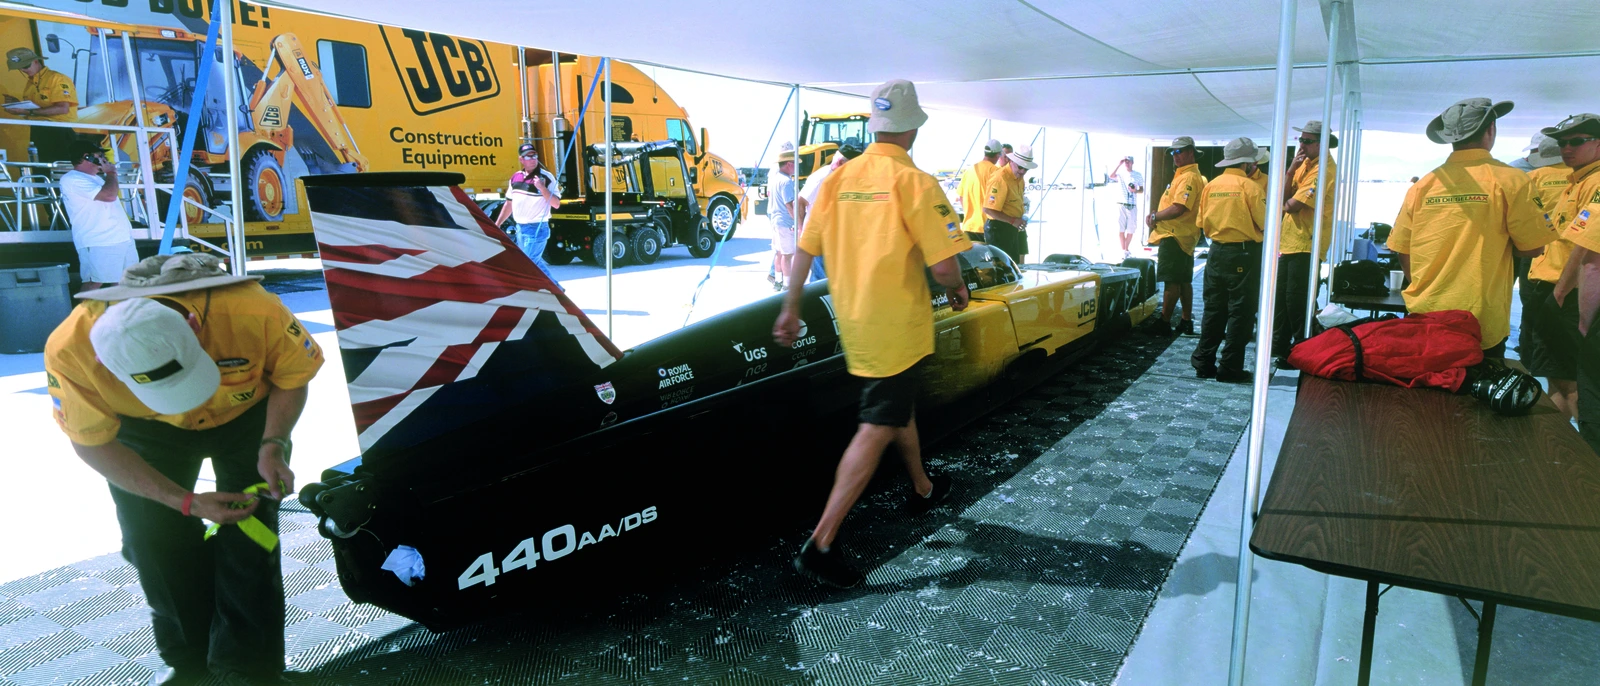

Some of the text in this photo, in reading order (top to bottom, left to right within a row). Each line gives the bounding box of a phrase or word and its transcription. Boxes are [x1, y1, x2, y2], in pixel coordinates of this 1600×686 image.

[402, 28, 492, 104] JCB
[263, 107, 280, 125] JCB
[389, 126, 503, 147] Construction
[402, 147, 497, 169] Equipment
[712, 159, 723, 177] JCB
[1077, 298, 1096, 319] JCB
[791, 335, 817, 350] corus
[744, 347, 767, 362] UGS
[667, 363, 691, 377] ROYAL
[658, 371, 695, 390] AIR FORCE
